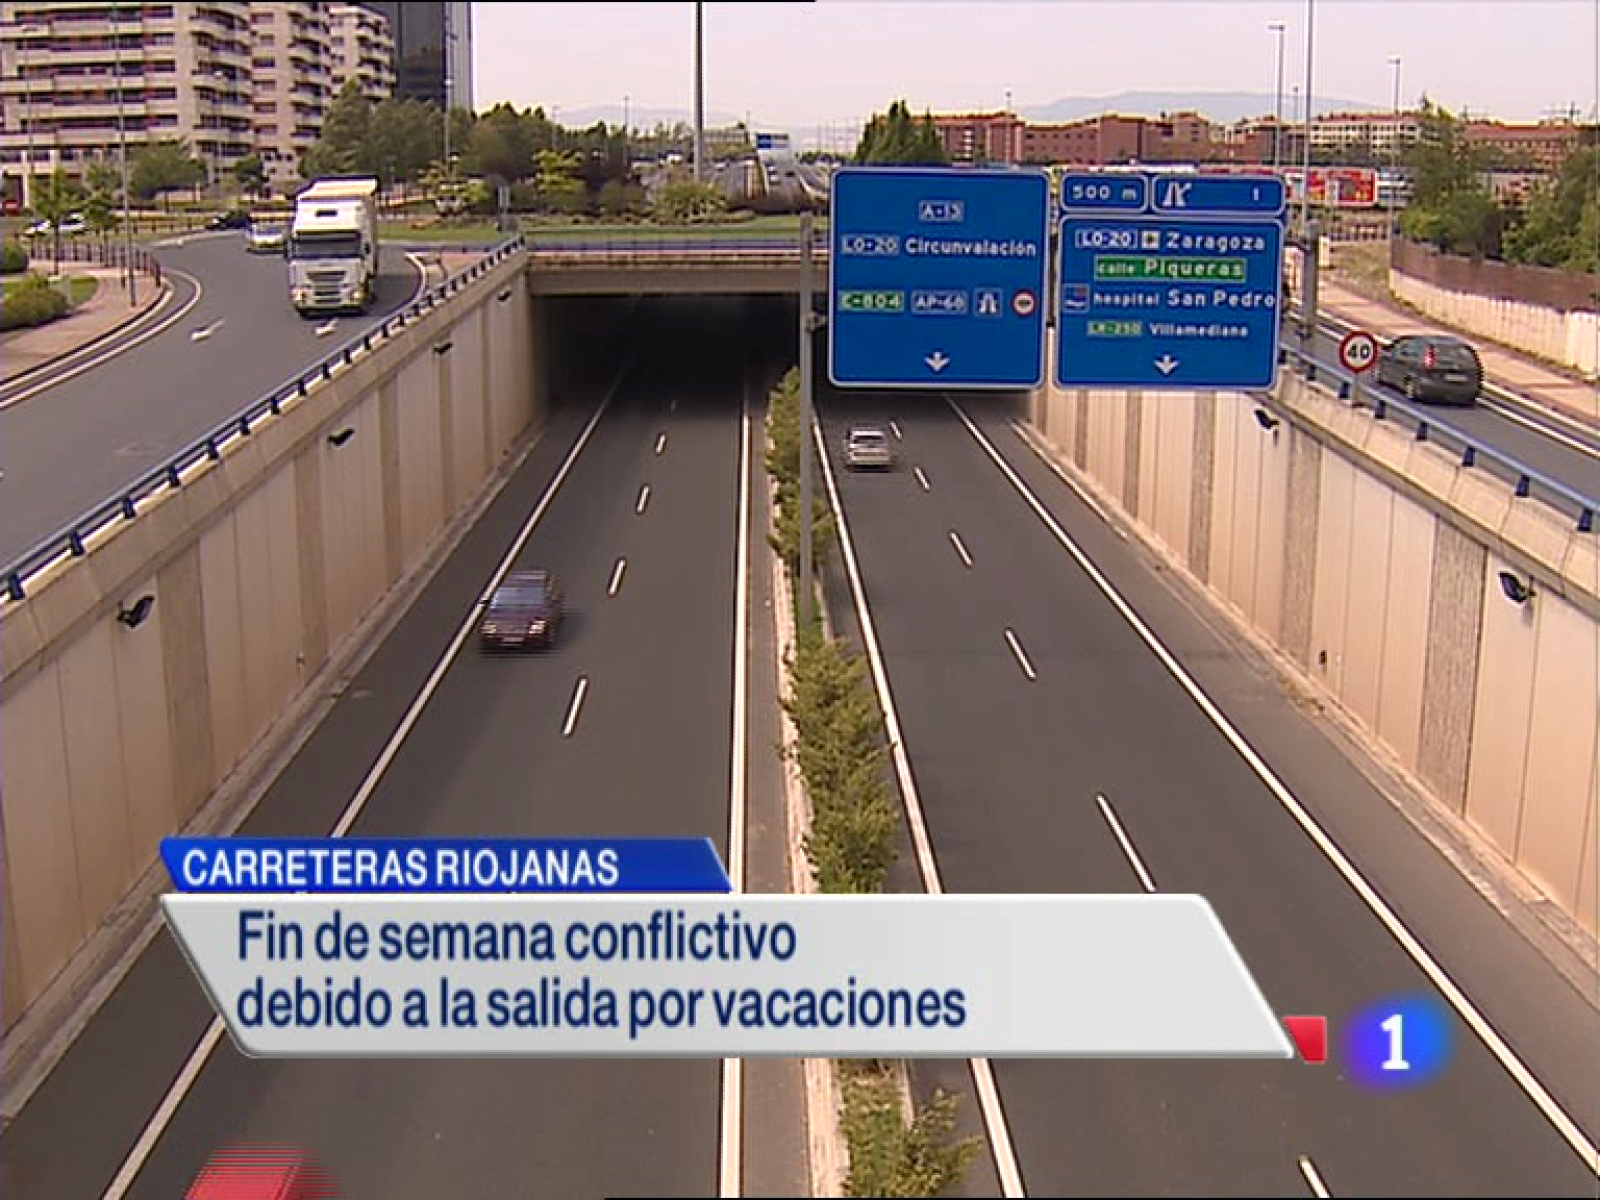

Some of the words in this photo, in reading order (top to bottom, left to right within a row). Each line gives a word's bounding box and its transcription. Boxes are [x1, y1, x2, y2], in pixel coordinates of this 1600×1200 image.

[1072, 184, 1111, 200] 500
[1122, 187, 1137, 200] m
[844, 237, 898, 254] LO-20
[905, 236, 1037, 258] Circunvalación
[1081, 231, 1132, 247] LO-20
[1166, 231, 1265, 253] Zaragoza
[1145, 258, 1243, 278] Piqueras
[1093, 291, 1160, 307] hospital
[1168, 288, 1206, 306] San
[1212, 289, 1276, 307] Pedro
[1149, 321, 1249, 337] Villamediana
[1347, 343, 1371, 359] 40
